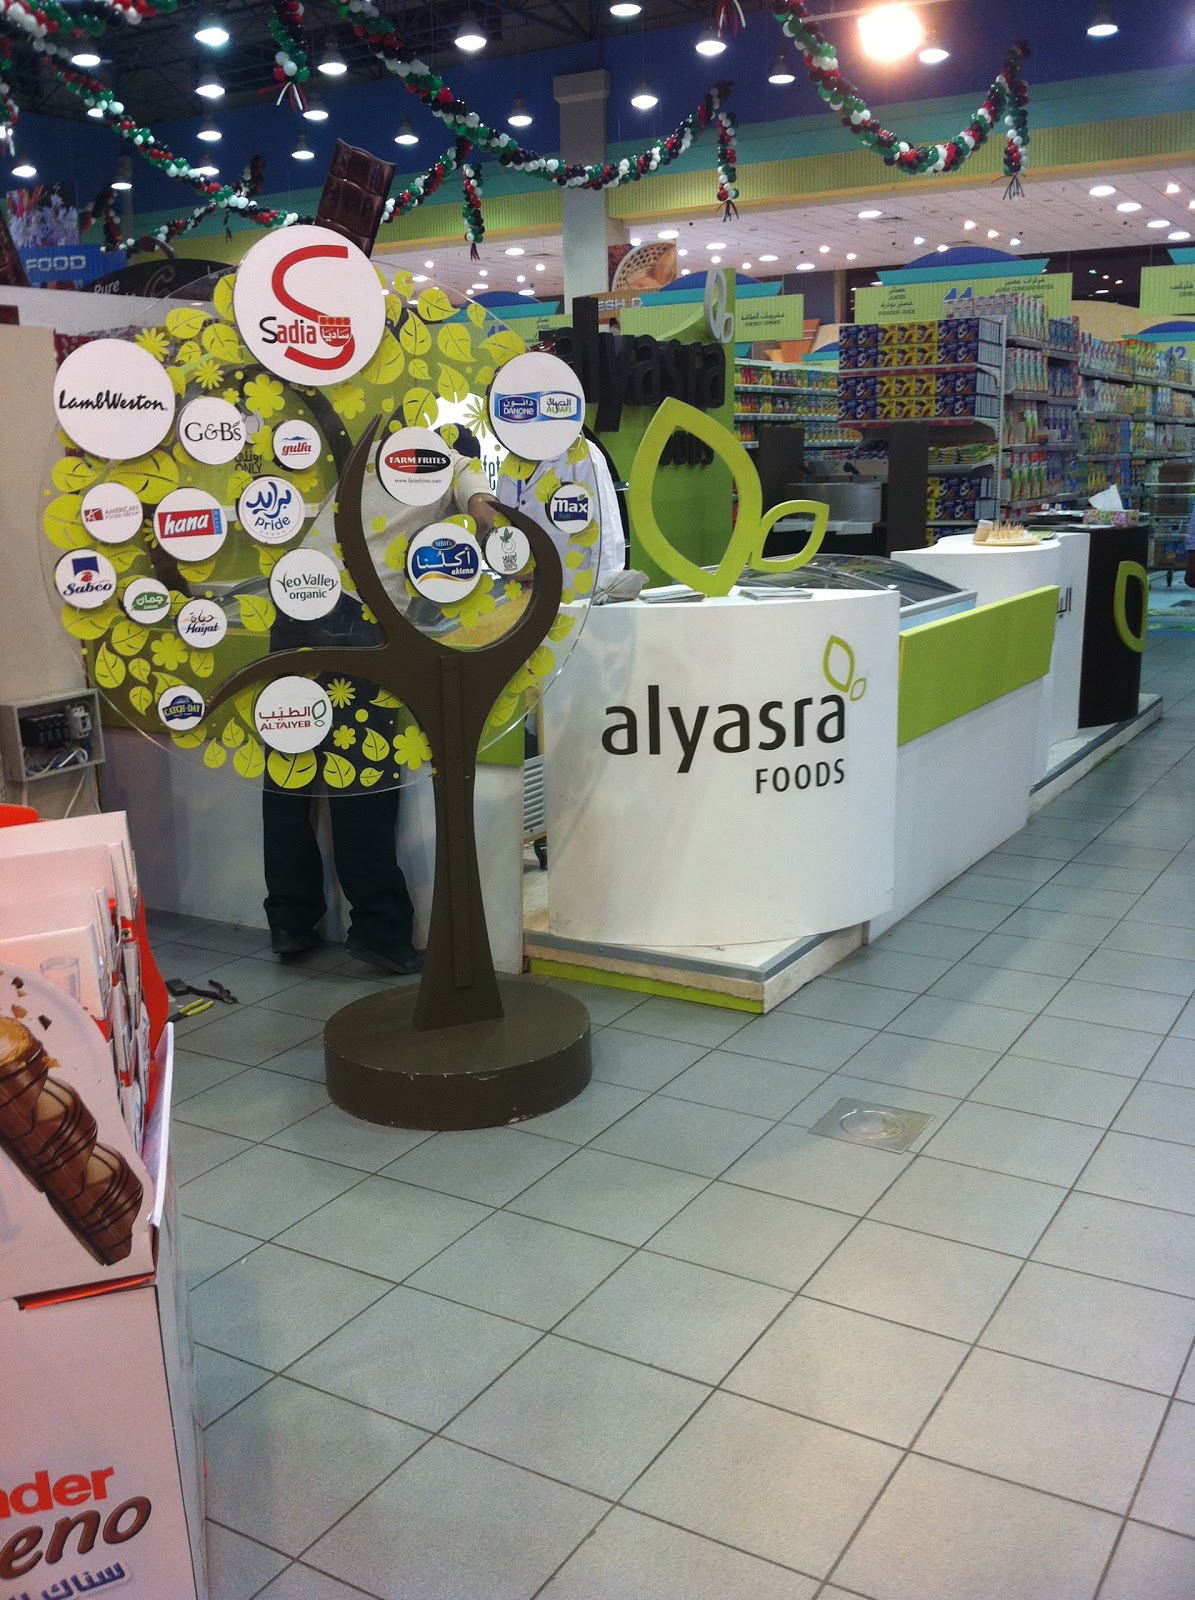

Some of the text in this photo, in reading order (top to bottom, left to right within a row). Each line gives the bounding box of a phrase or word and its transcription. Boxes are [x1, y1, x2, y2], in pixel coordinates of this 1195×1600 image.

[25, 254, 87, 273] FOOD
[598, 298, 626, 312] ESH
[259, 316, 317, 344] Sadia
[281, 441, 312, 456] gulfa
[235, 462, 263, 475] ONLY
[389, 456, 447, 465] FARM FRITES
[163, 513, 210, 536] hana
[254, 516, 291, 531] pride
[63, 581, 113, 597] Sabco
[276, 570, 339, 594] Yeo Valley
[289, 588, 328, 602] organic
[185, 621, 220, 636] Hayat
[260, 720, 312, 732] ALTAIYEB
[601, 684, 846, 774] alyasra
[756, 758, 846, 794] FOODS
[0, 1466, 115, 1520] der
[0, 1495, 152, 1580] eno
